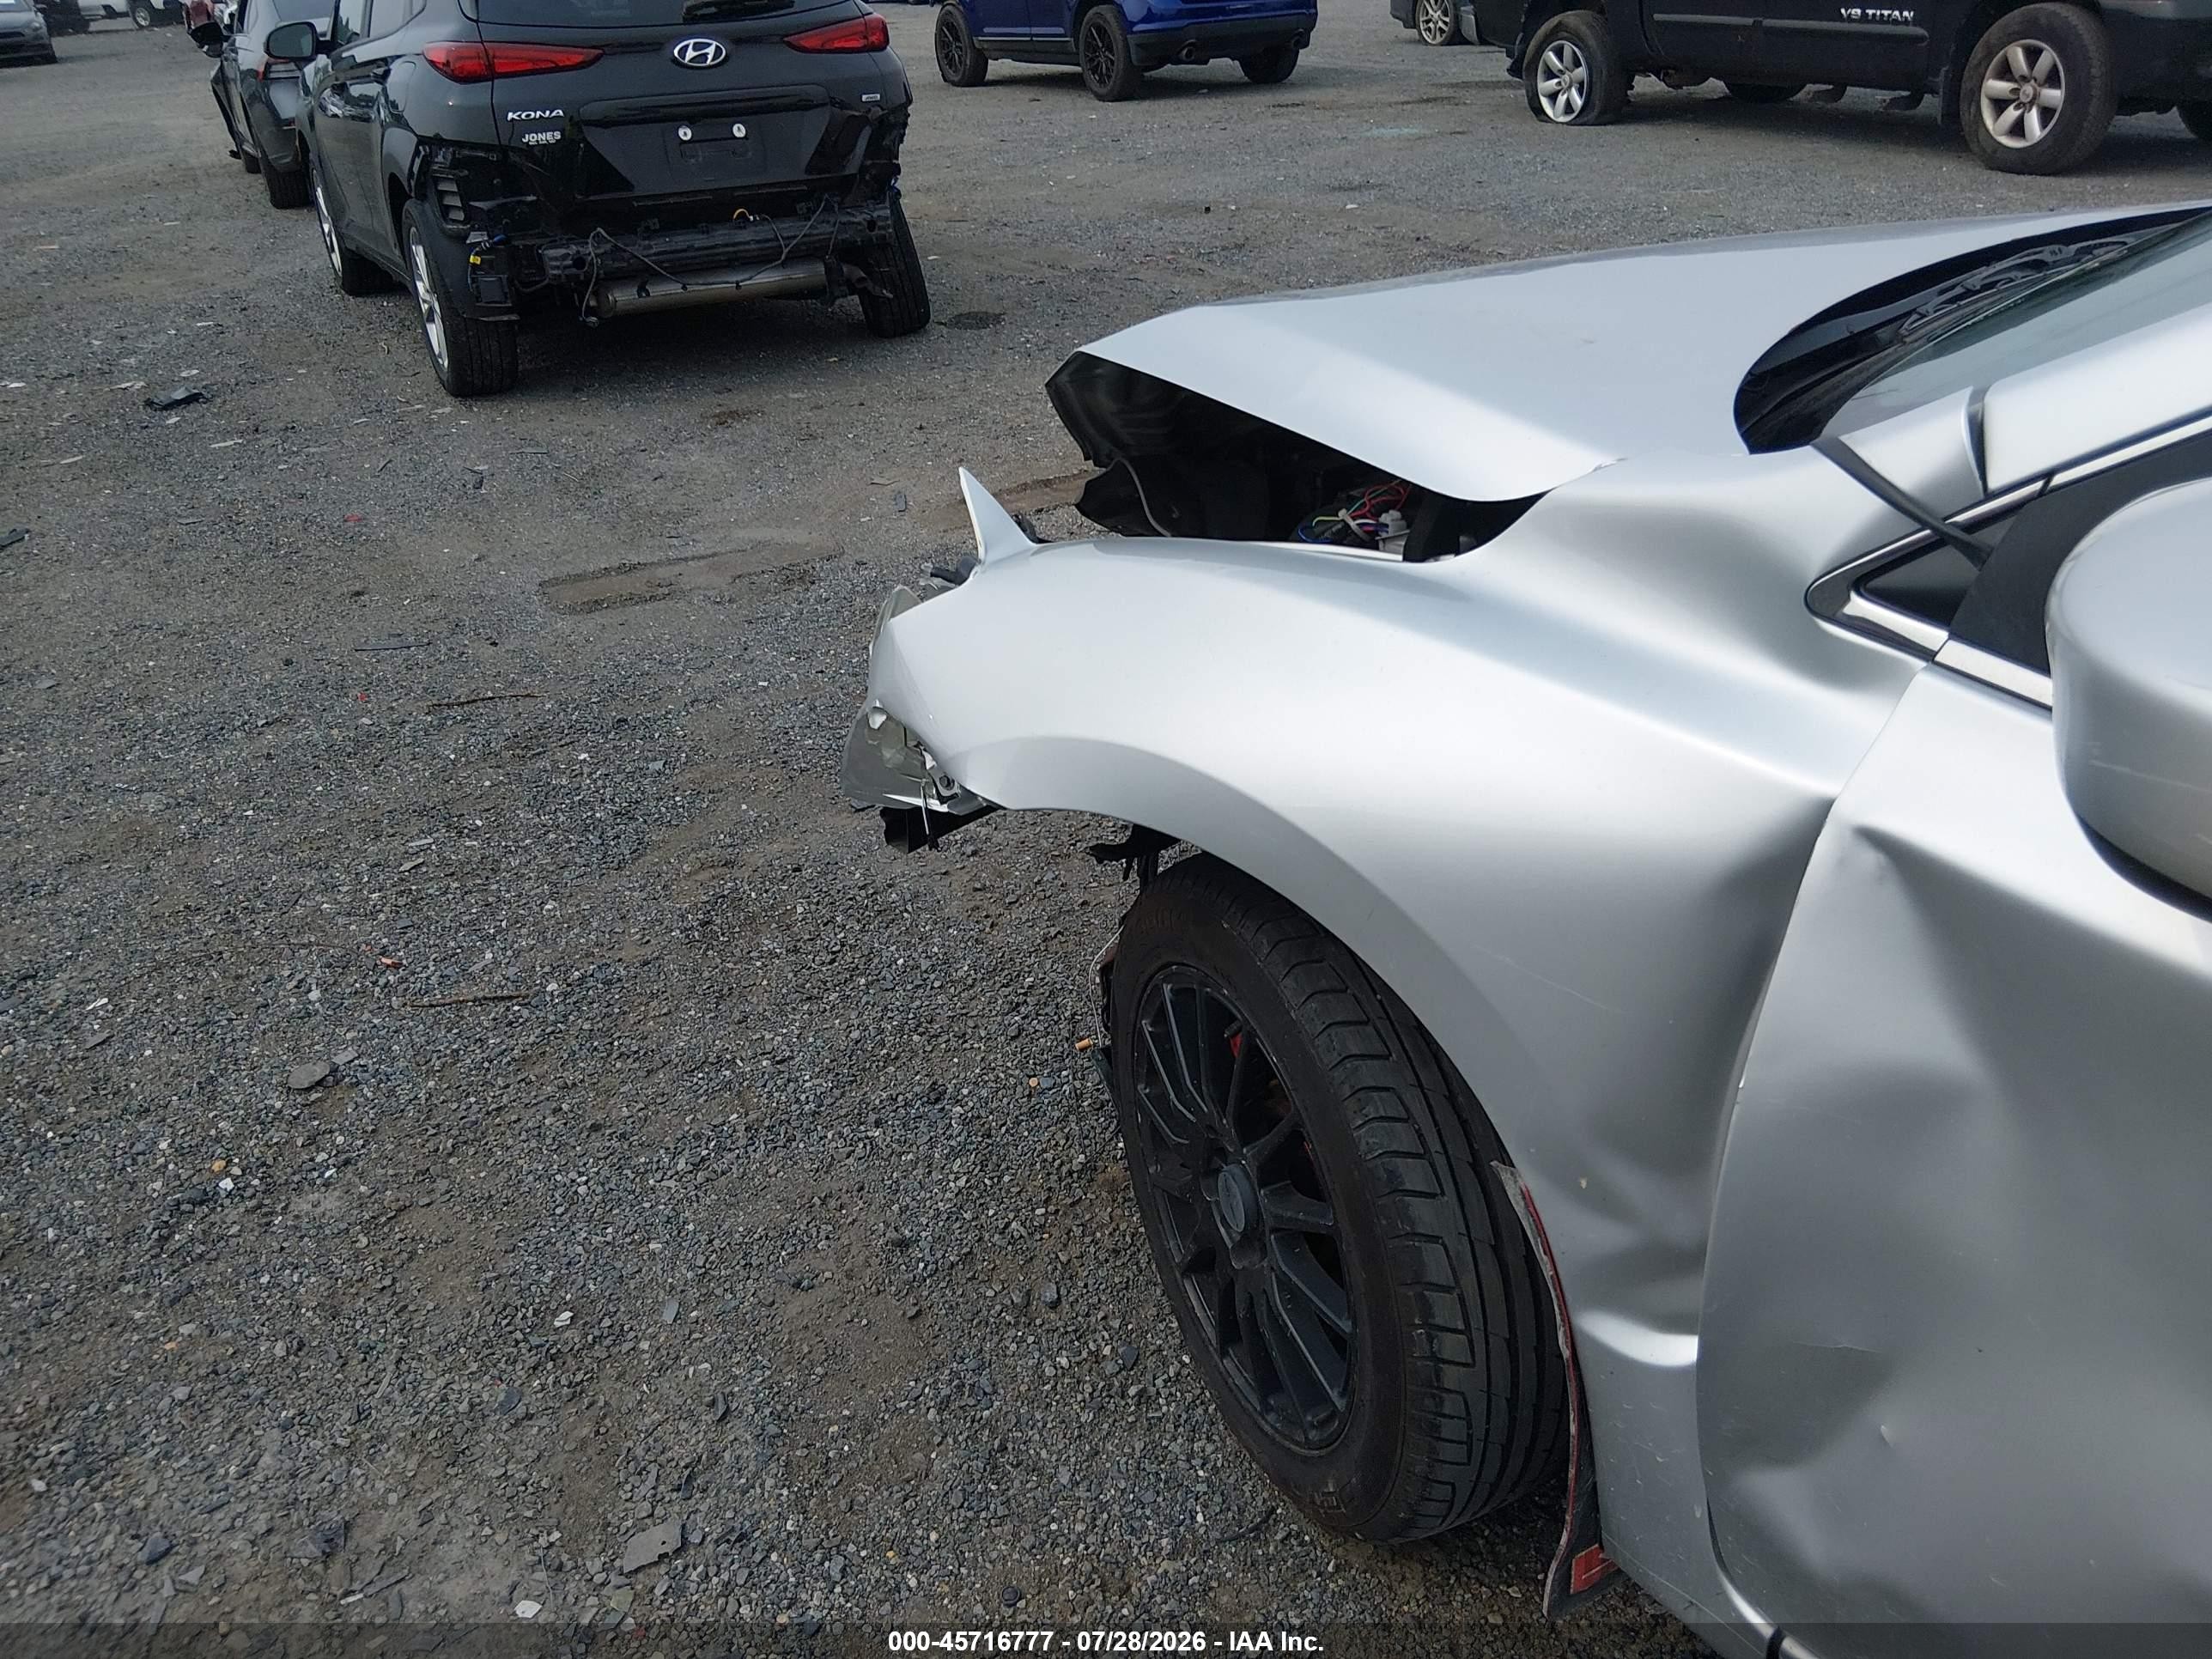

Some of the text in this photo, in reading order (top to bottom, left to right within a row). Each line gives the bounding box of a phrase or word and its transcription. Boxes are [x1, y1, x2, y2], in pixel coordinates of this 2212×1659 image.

[1839, 8, 1914, 21] V8 TITAN
[507, 109, 564, 121] KONA
[521, 131, 562, 143] JONES
